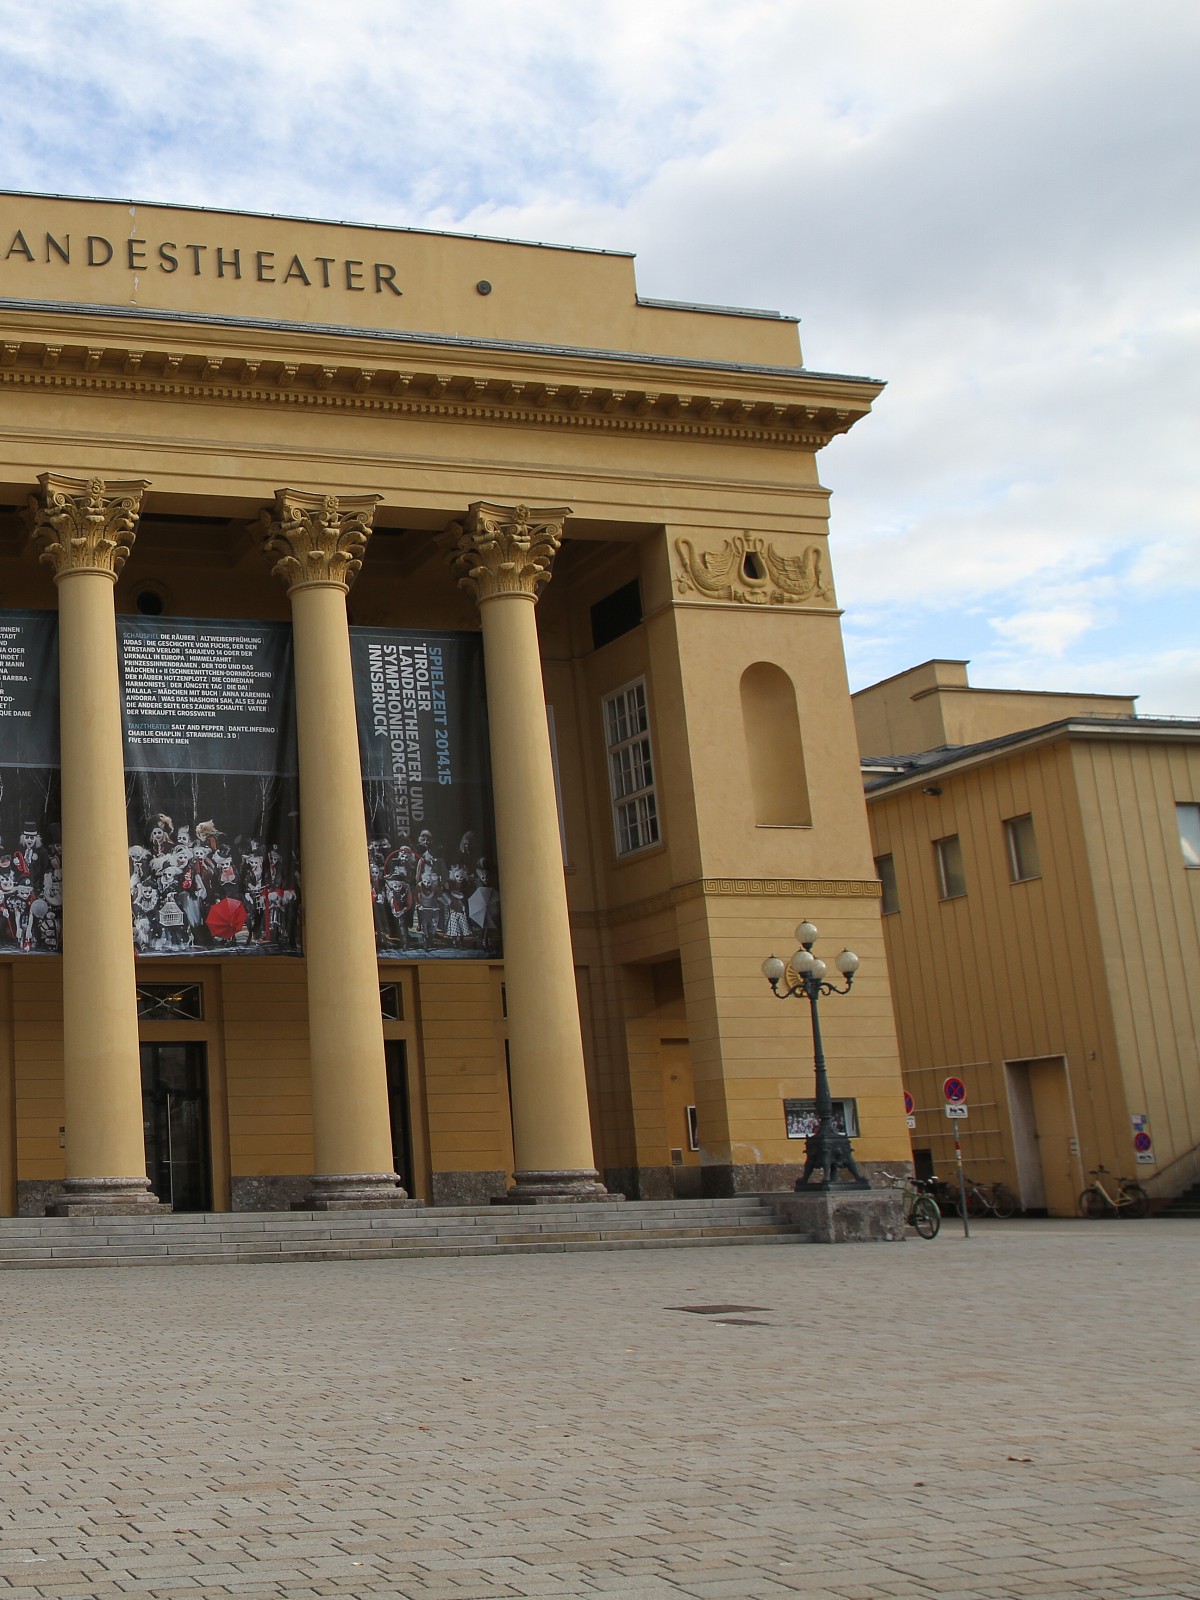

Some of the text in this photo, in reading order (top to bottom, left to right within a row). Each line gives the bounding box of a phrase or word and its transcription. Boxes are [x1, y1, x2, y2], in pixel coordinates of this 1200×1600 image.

[368, 644, 388, 737] INNSBRUCK
[384, 644, 410, 837] SYMPHONIEORCHESTER
[399, 645, 424, 822] LANDESTHEATER UND
[414, 643, 432, 712] TIROLER
[429, 647, 452, 785] SPIELZEIT 2014.15
